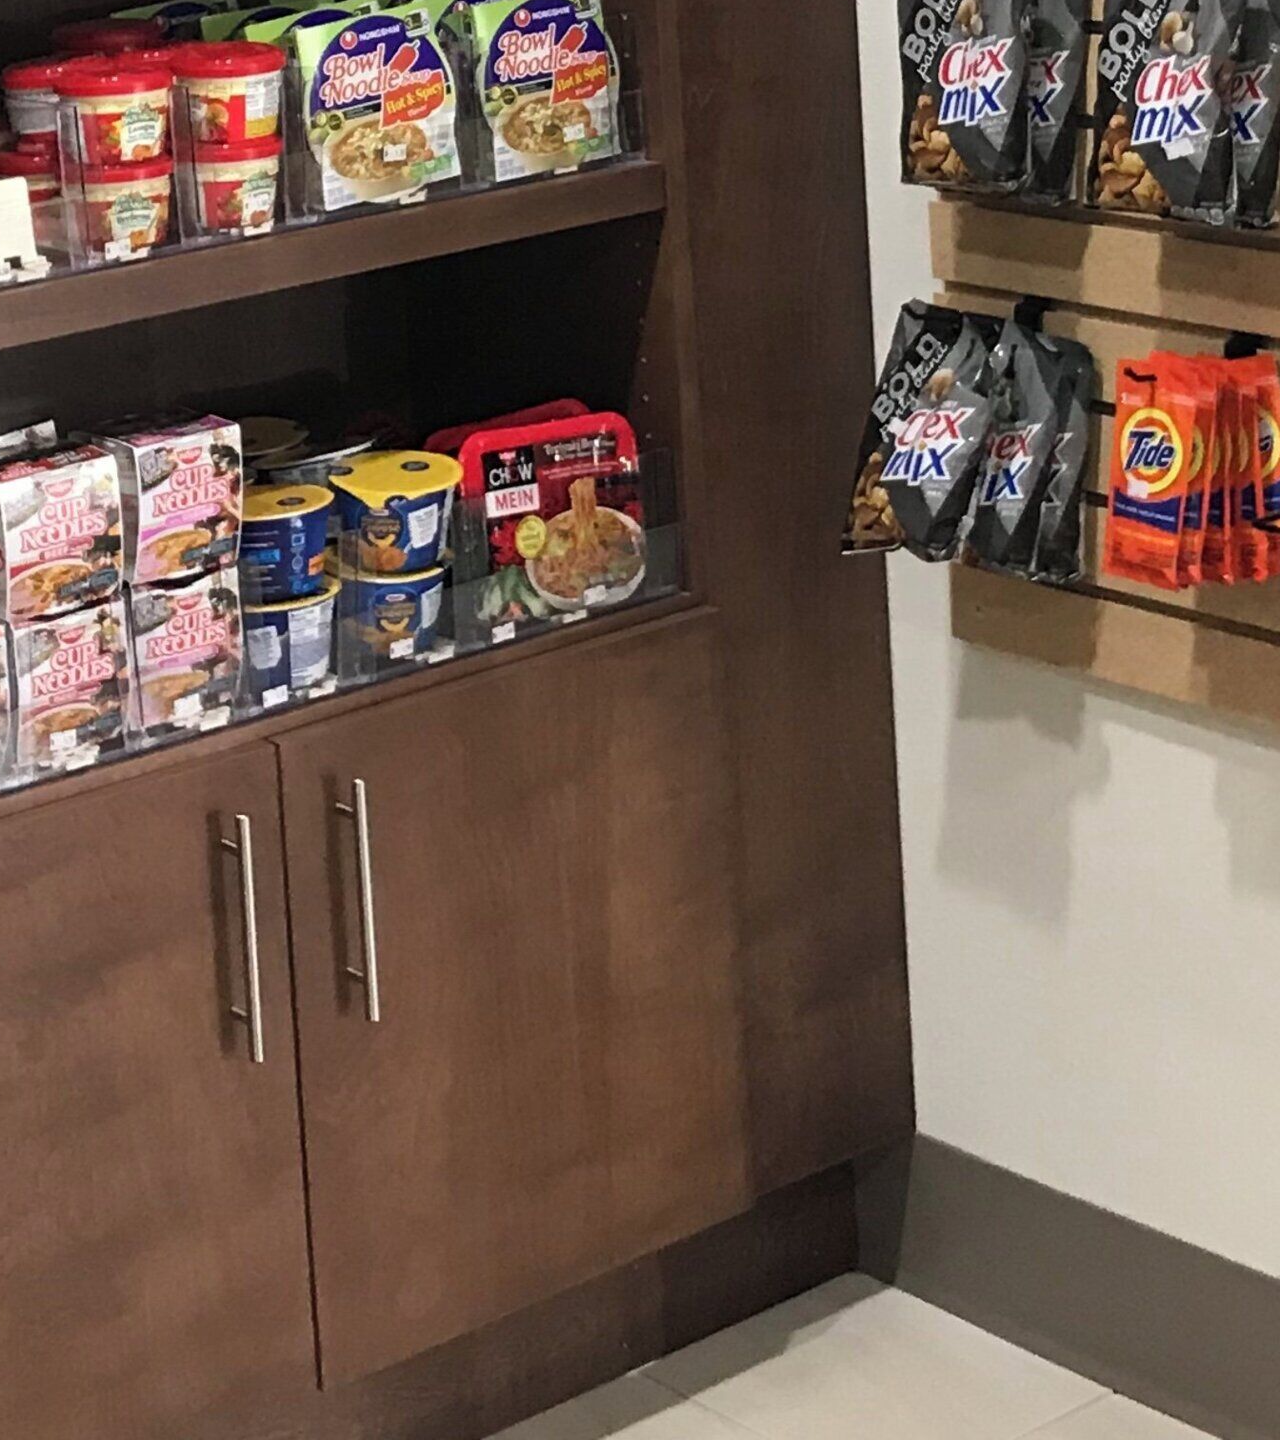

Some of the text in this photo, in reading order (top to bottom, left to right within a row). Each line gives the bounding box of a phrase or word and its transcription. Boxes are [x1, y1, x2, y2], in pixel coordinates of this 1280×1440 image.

[498, 22, 557, 58] Bowl
[323, 43, 386, 82] Bowl
[494, 47, 570, 82] Noodle
[1135, 55, 1212, 106] Chex
[320, 68, 401, 108] Noodle
[385, 96, 406, 114] Hot
[417, 82, 443, 102] Spicy
[939, 77, 1007, 126] mix
[1131, 95, 1207, 144] mix
[871, 332, 938, 424] BOLD
[880, 442, 962, 484] mix
[1125, 429, 1175, 472] Tide
[170, 463, 215, 492] CUP
[38, 492, 90, 526] CUP
[151, 477, 231, 518] NOODLES
[494, 489, 535, 511] MEIN
[20, 511, 108, 553] NOODLES
[166, 608, 214, 634] CUP
[51, 640, 99, 672] CUP
[146, 622, 228, 660] NOODLES
[31, 654, 115, 697] NOODLES
